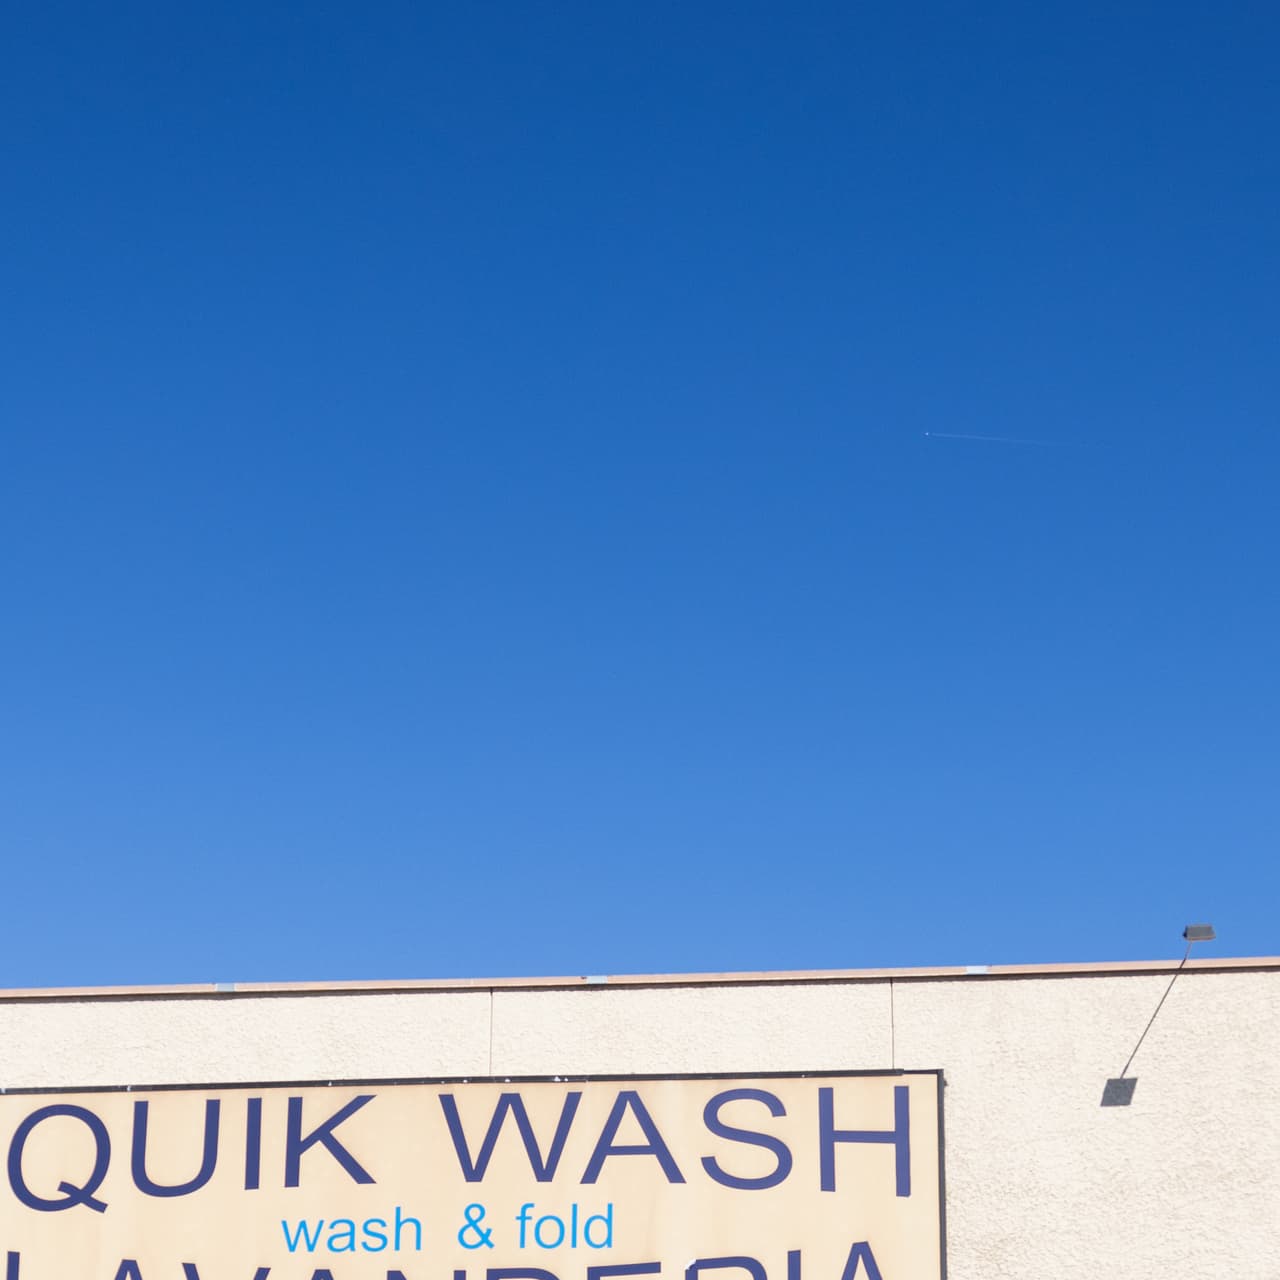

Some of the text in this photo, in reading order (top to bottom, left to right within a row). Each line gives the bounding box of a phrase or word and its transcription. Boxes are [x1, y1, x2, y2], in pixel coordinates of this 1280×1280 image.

[7, 1086, 911, 1213] QUIK WASH
[281, 1202, 614, 1253] wash & fold
